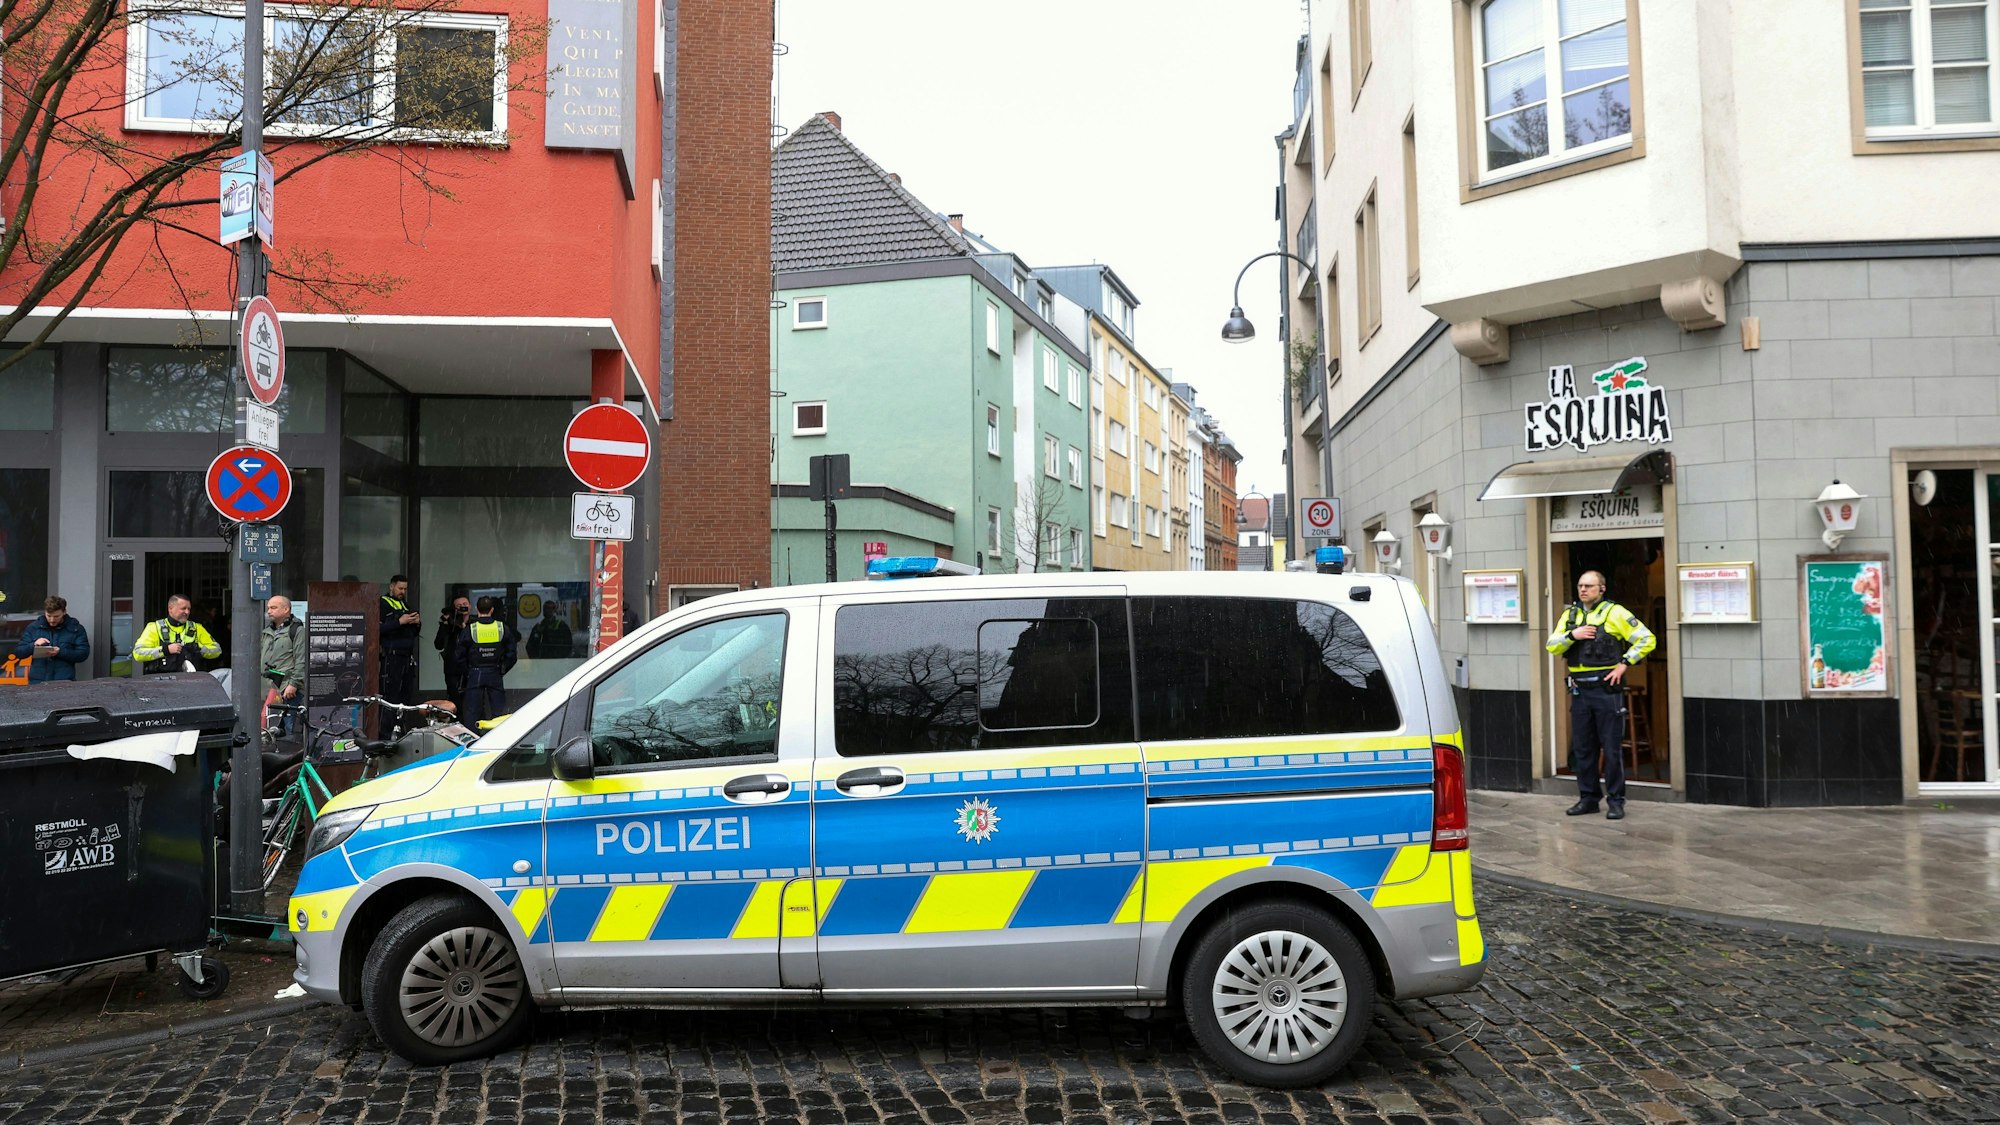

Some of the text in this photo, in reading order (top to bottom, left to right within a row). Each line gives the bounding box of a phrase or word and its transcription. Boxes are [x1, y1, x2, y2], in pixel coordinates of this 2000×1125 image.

[565, 26, 618, 42] VENI,
[564, 45, 599, 60] QUI
[564, 65, 619, 79] LEGEM
[564, 83, 581, 97] IN
[563, 102, 621, 118] GAUDE,
[1551, 367, 1574, 398] LA
[251, 410, 275, 432] Anlieger
[1527, 388, 1670, 450] ESQUINA
[259, 428, 269, 441] frei
[1313, 508, 1328, 520] 30
[1580, 497, 1639, 519] ESQUINA
[593, 524, 612, 534] frei
[35, 819, 87, 832] RESTMÜLL
[595, 816, 751, 856] POLIZEI
[70, 844, 115, 867] AWB
